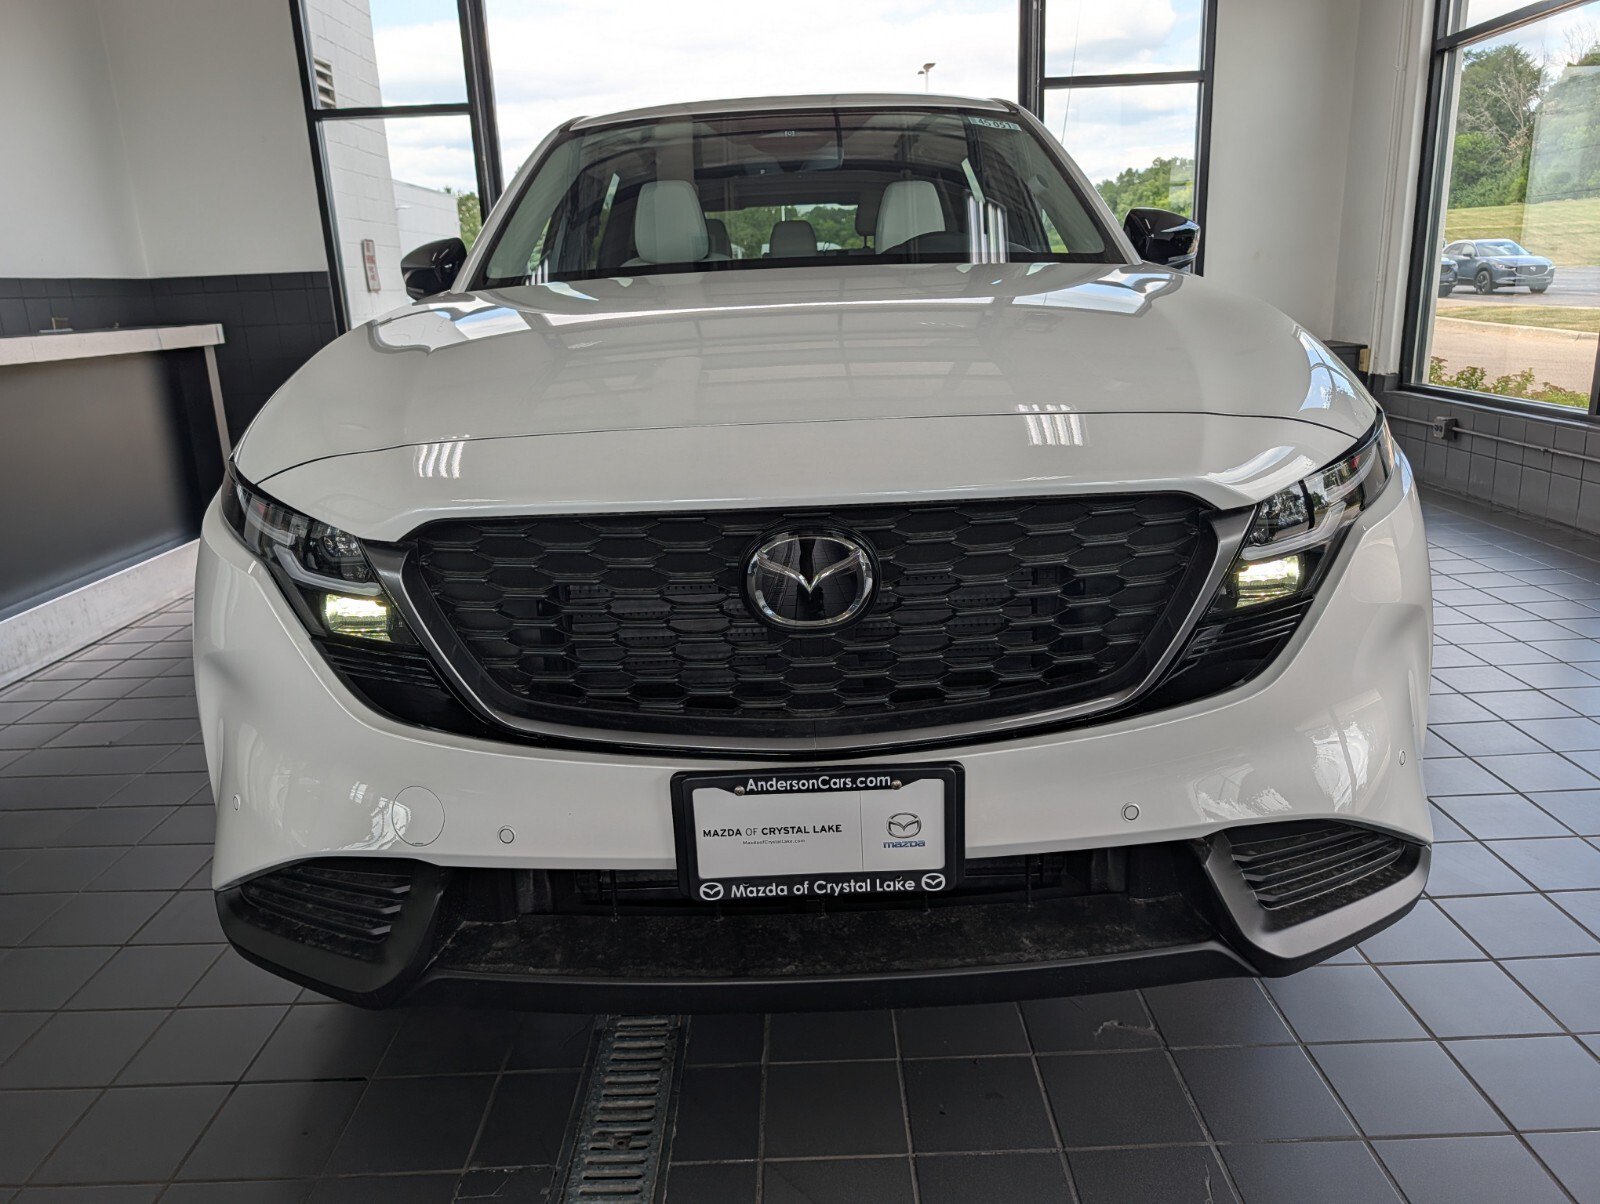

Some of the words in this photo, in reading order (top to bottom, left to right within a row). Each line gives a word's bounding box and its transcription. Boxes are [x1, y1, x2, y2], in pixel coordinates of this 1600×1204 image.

[746, 775, 891, 792] AndersonCars.com
[703, 828, 742, 837] MAZDA
[745, 827, 758, 837] OF
[761, 825, 810, 836] CRYSTAL
[813, 824, 842, 834] LAKE
[731, 882, 788, 898] Mazda
[793, 881, 809, 895] of
[813, 878, 871, 896] Crystal
[876, 878, 915, 892] Lake
